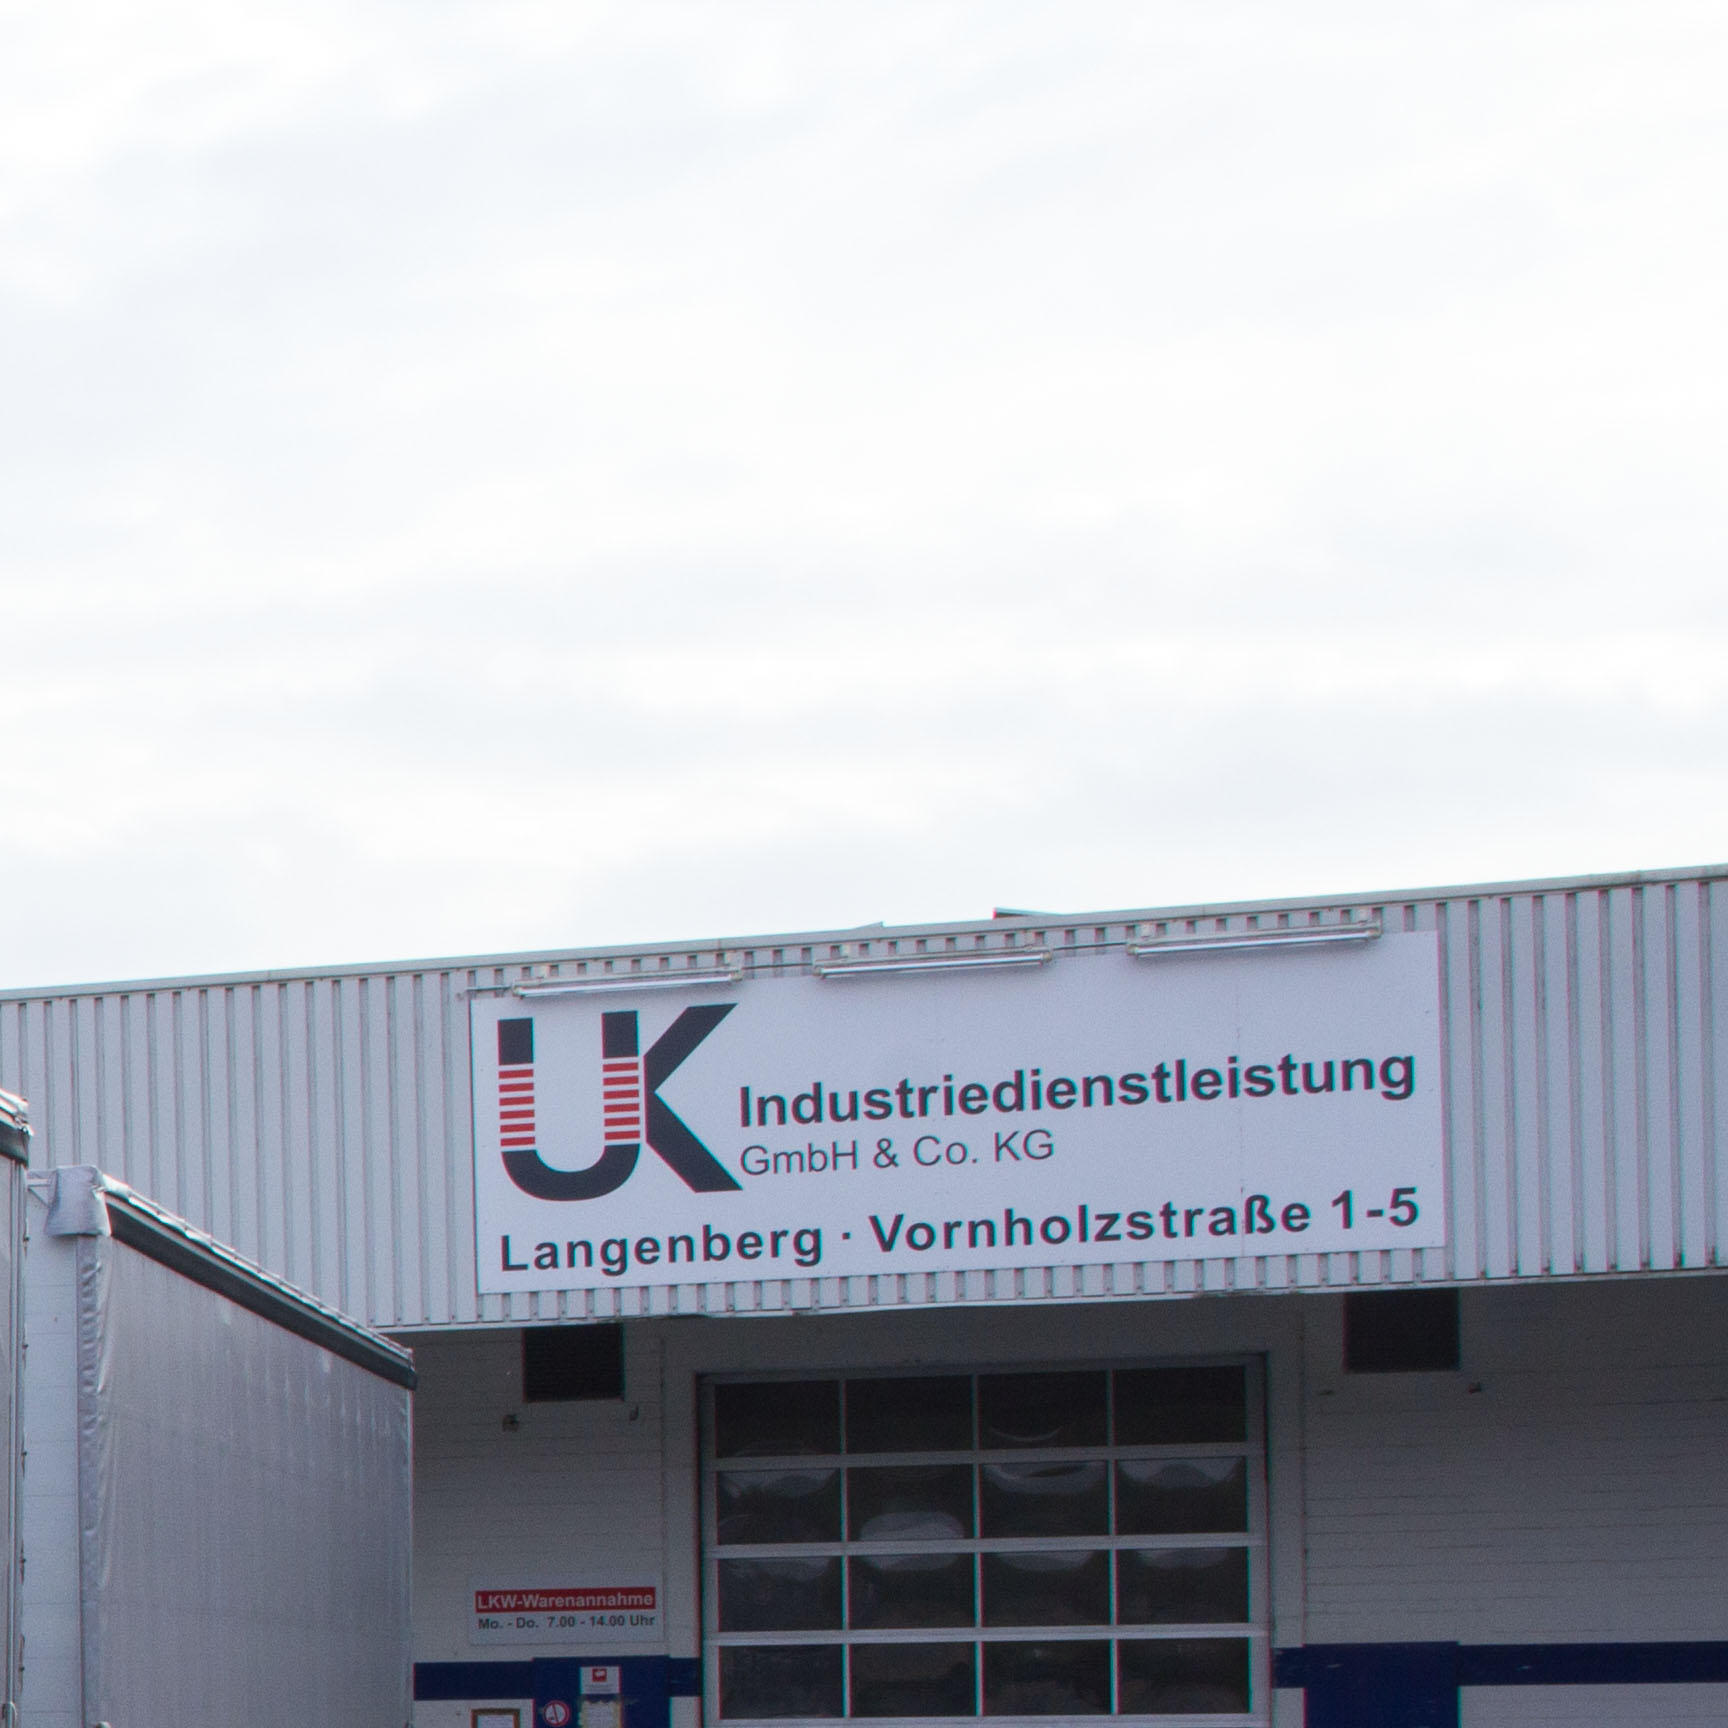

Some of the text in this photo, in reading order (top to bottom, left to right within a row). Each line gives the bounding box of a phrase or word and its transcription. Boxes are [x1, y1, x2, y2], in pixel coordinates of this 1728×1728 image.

[498, 1002, 744, 1202] UK
[739, 1053, 1416, 1128] Industriedienstleistung
[739, 1129, 1054, 1176] GmbH & Co. KG
[500, 1224, 822, 1277] Langenberg
[868, 1193, 1311, 1253] Vornholzstraße
[1331, 1187, 1420, 1230] 1-5
[478, 1592, 652, 1609] LKW-Warenannahme
[629, 1614, 655, 1627] Uhr
